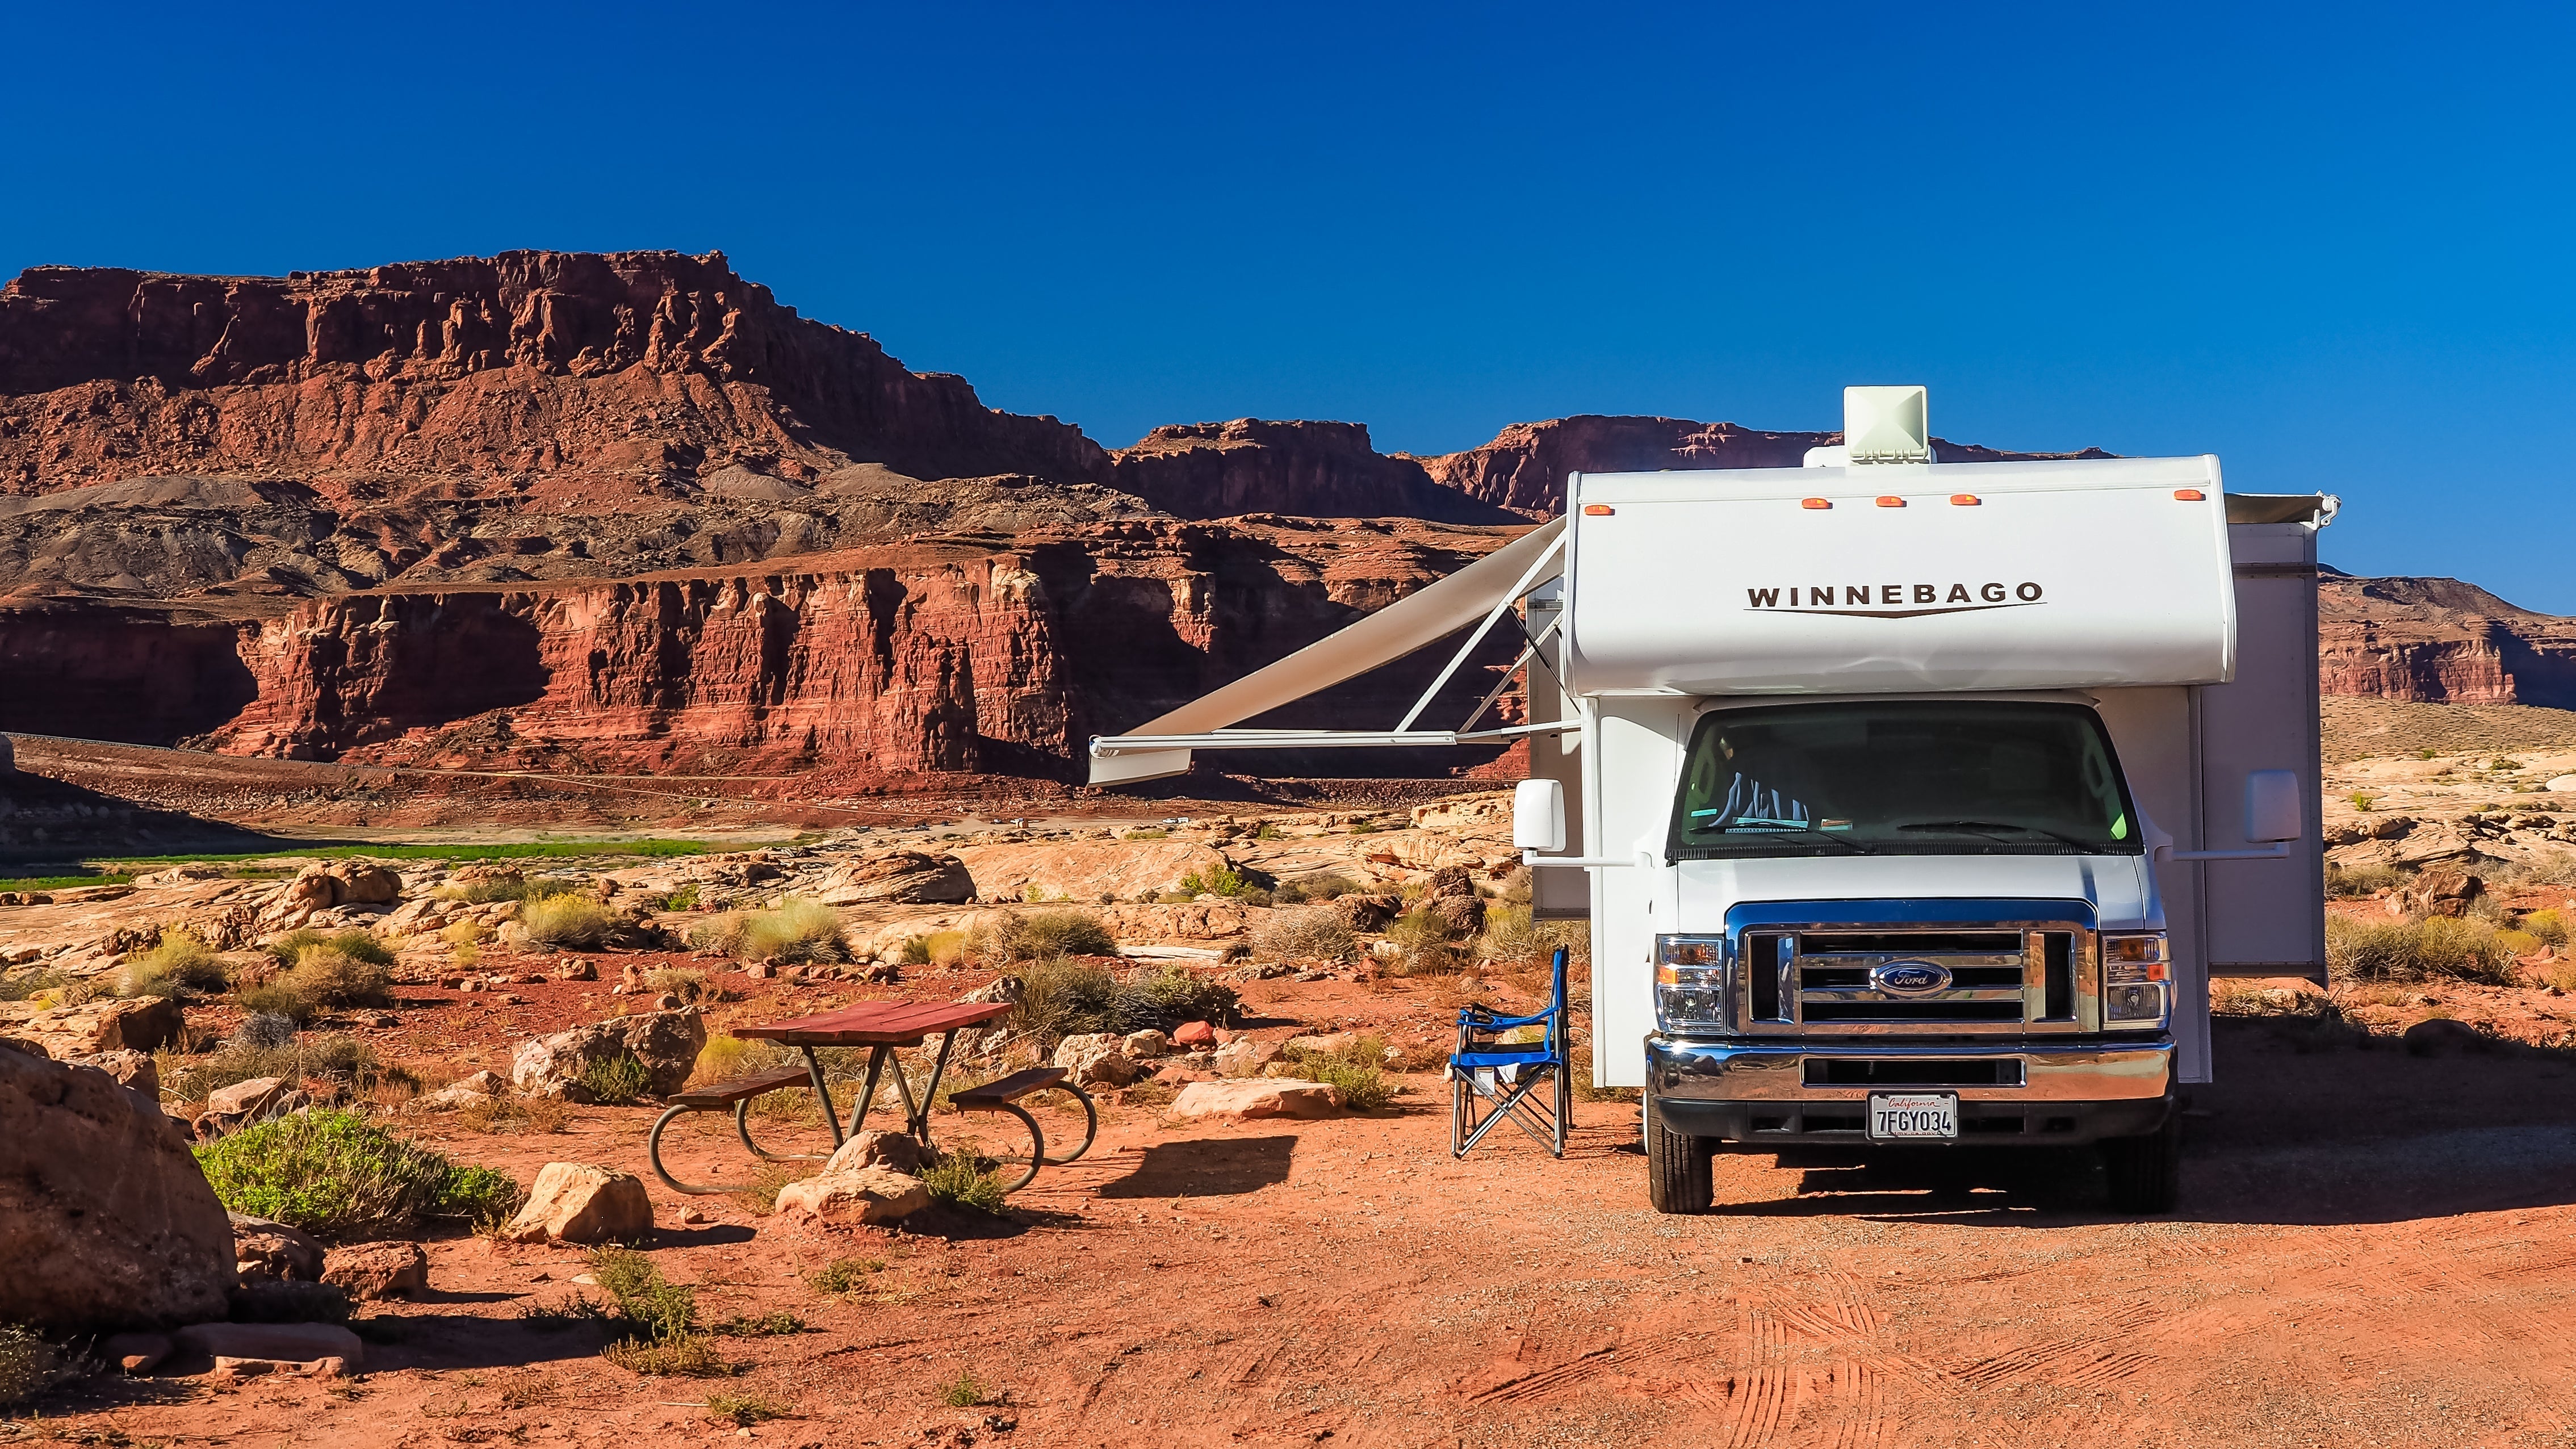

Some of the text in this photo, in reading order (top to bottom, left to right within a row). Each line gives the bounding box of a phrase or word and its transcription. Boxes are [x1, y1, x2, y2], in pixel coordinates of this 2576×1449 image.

[1747, 582, 2043, 608] WINNEBAGO
[1894, 970, 1928, 985] Ford
[1888, 1097, 1941, 1110] California
[1876, 1111, 1952, 1131] 7FGY034
